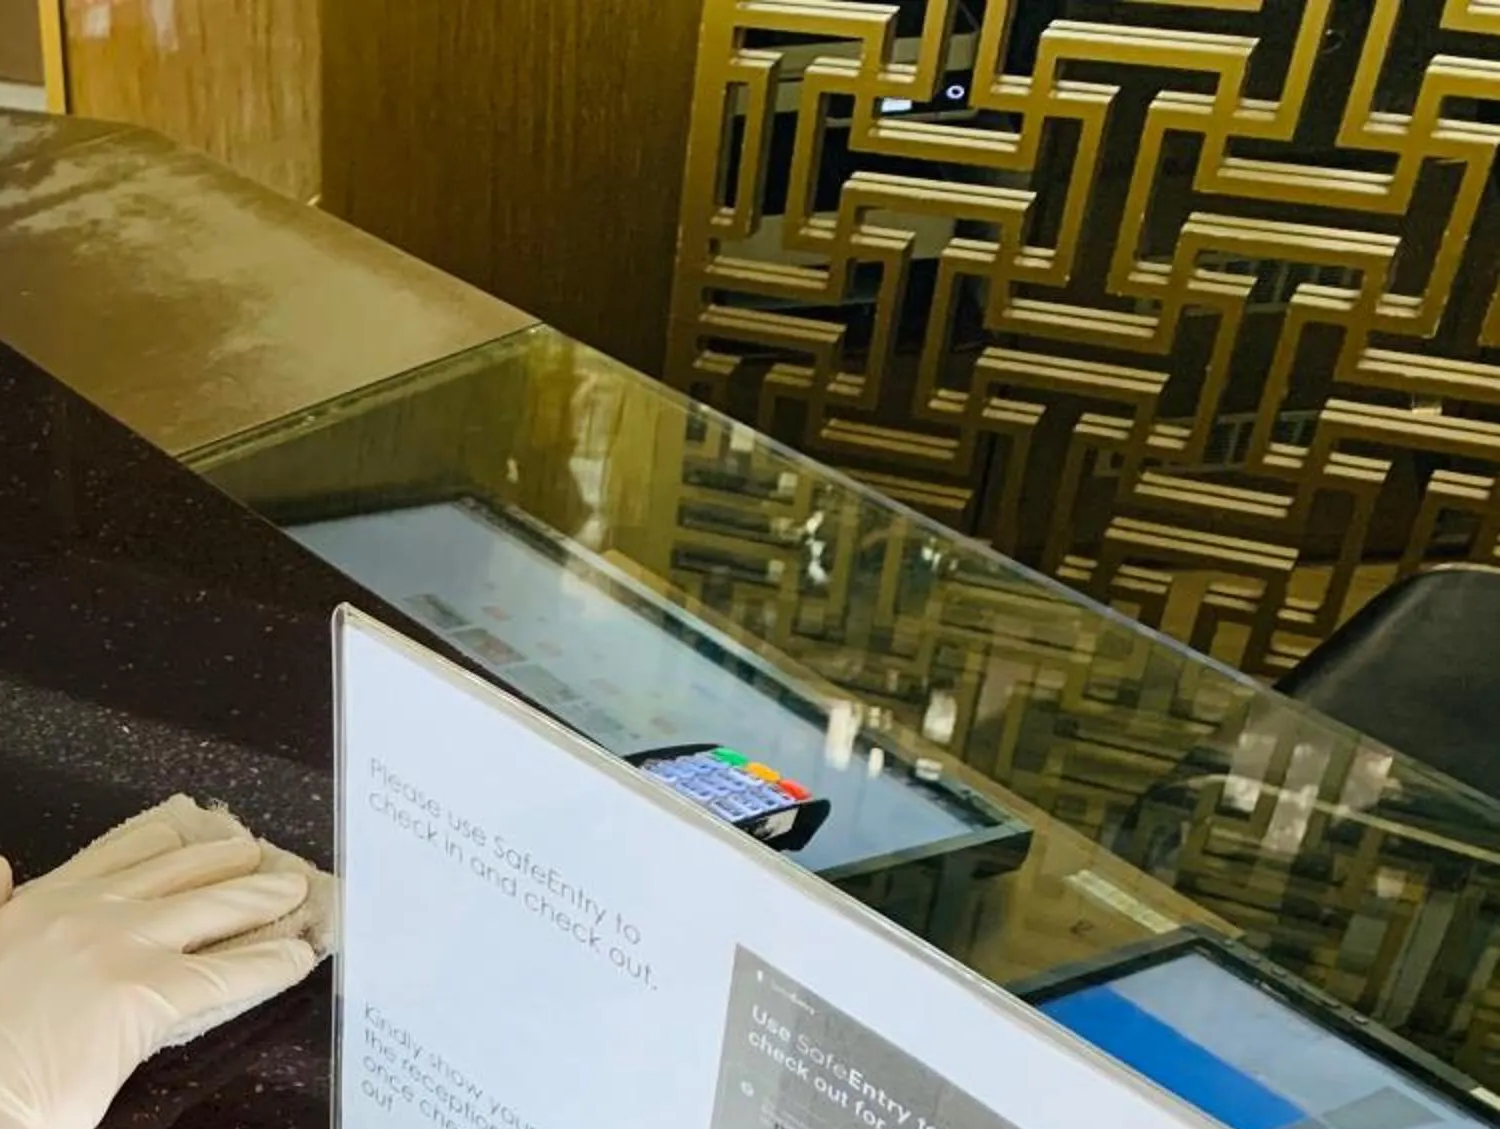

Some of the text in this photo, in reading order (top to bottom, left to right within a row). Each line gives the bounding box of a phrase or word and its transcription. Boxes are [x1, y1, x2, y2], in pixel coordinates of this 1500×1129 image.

[368, 792, 658, 991] check in and check out.
[370, 757, 642, 945] Please use SafeEntry to
[362, 1055, 414, 1103] once
[364, 1028, 397, 1064] the
[364, 1001, 423, 1060] Kindly
[430, 1052, 483, 1101] show
[748, 1030, 809, 1082] check
[814, 1076, 848, 1108] out
[752, 1004, 791, 1043] Use
[796, 1033, 911, 1124] SafeEntry
[361, 1079, 394, 1113] out
